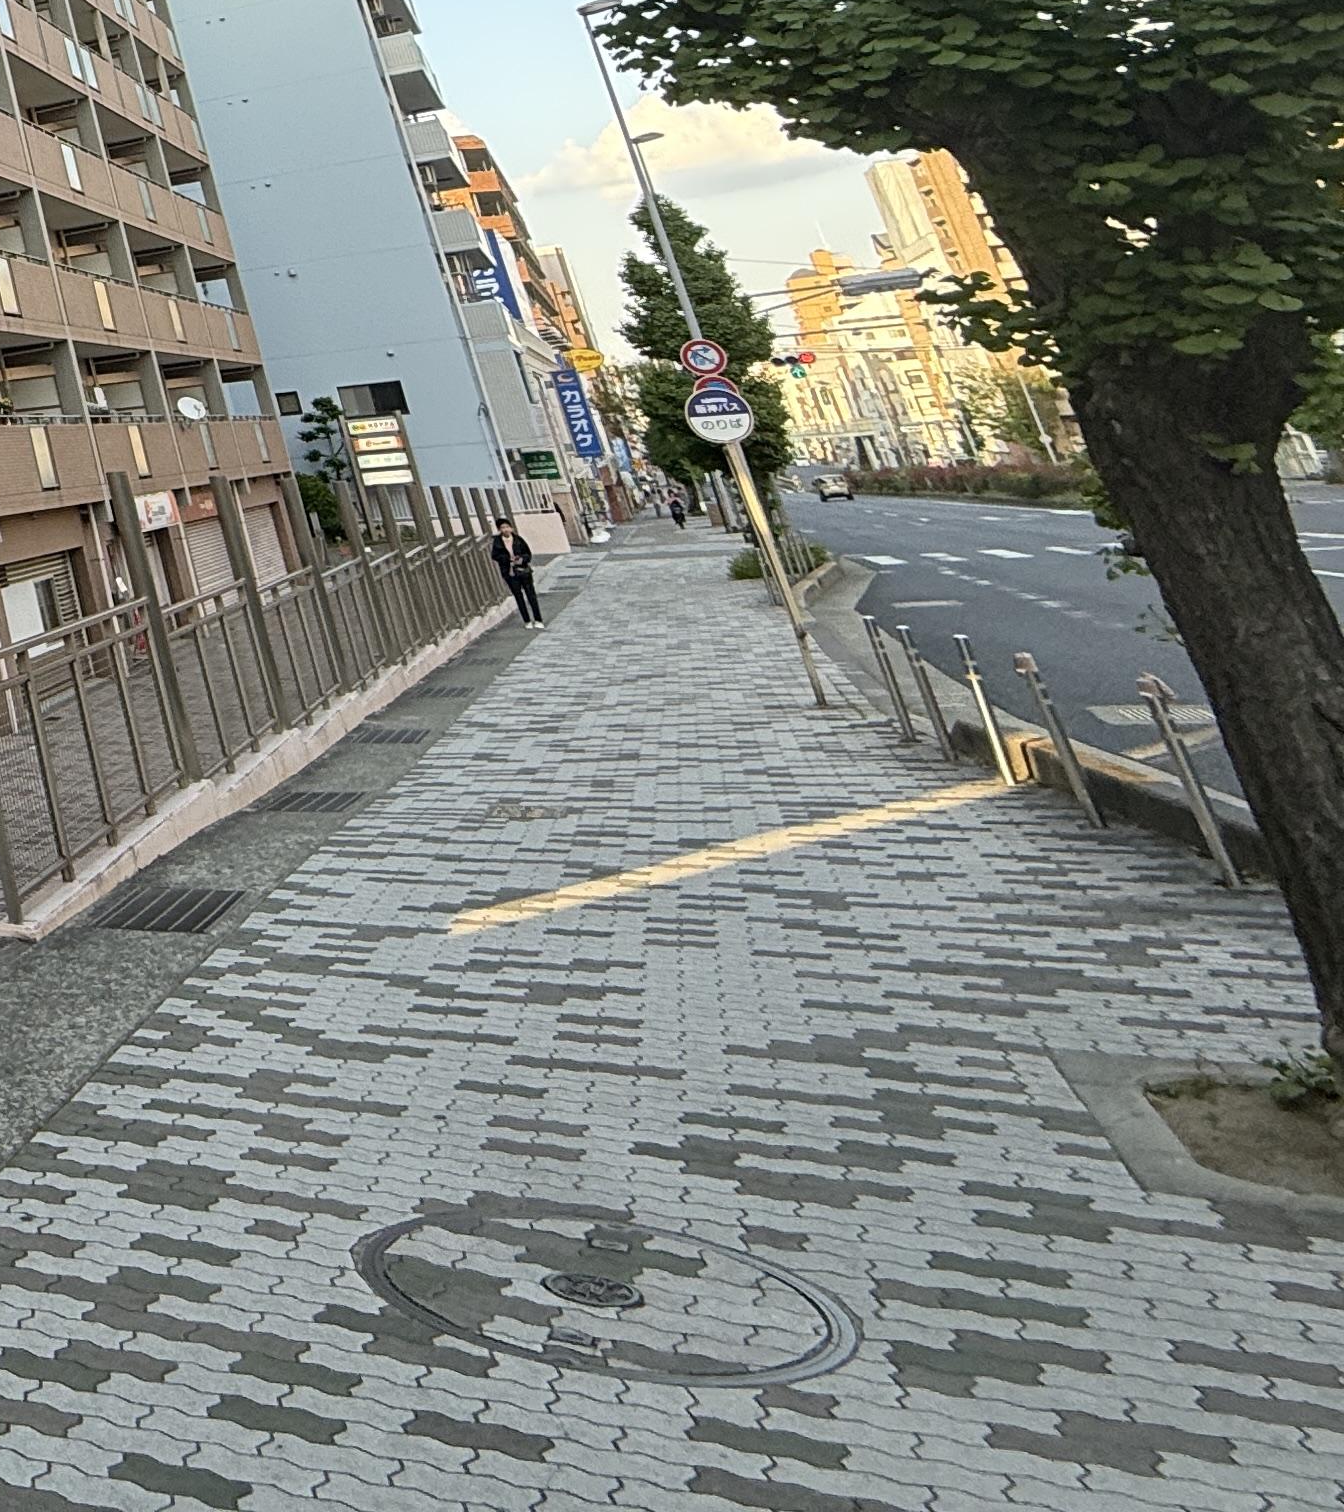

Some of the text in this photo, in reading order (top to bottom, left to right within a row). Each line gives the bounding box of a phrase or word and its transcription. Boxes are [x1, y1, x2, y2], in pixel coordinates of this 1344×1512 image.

[561, 390, 594, 448] カラオケ
[701, 418, 744, 430] のりば
